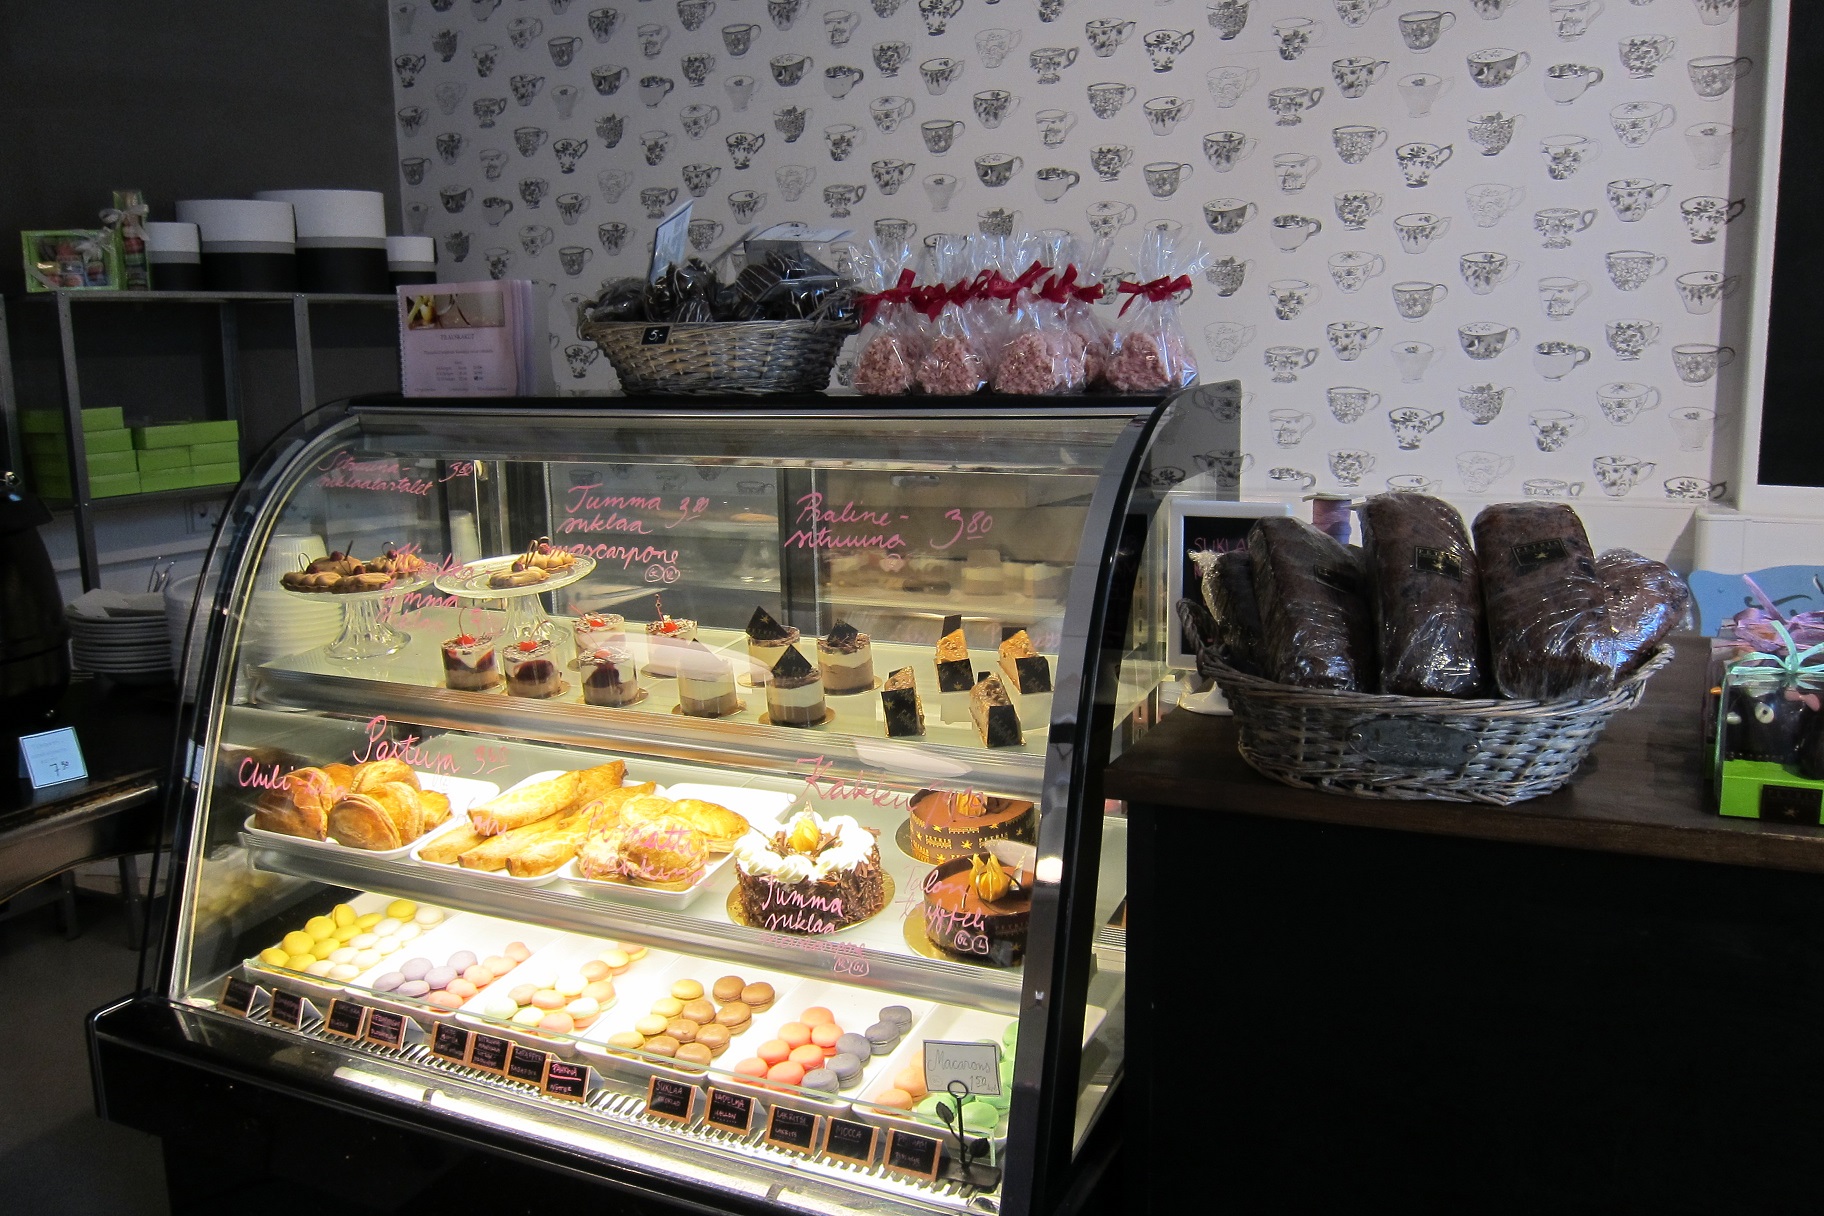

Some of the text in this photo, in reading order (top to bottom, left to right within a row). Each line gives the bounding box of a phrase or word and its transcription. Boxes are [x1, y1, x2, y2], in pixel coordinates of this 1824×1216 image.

[566, 483, 662, 514] Tumma
[556, 513, 653, 534] suklaa
[788, 754, 918, 812] Kakku
[759, 874, 843, 917] Tumma
[764, 910, 837, 933] suklaa
[927, 1048, 991, 1074] Macarons
[655, 1080, 683, 1095] SUKLAA
[835, 1125, 863, 1139] MOCCA
